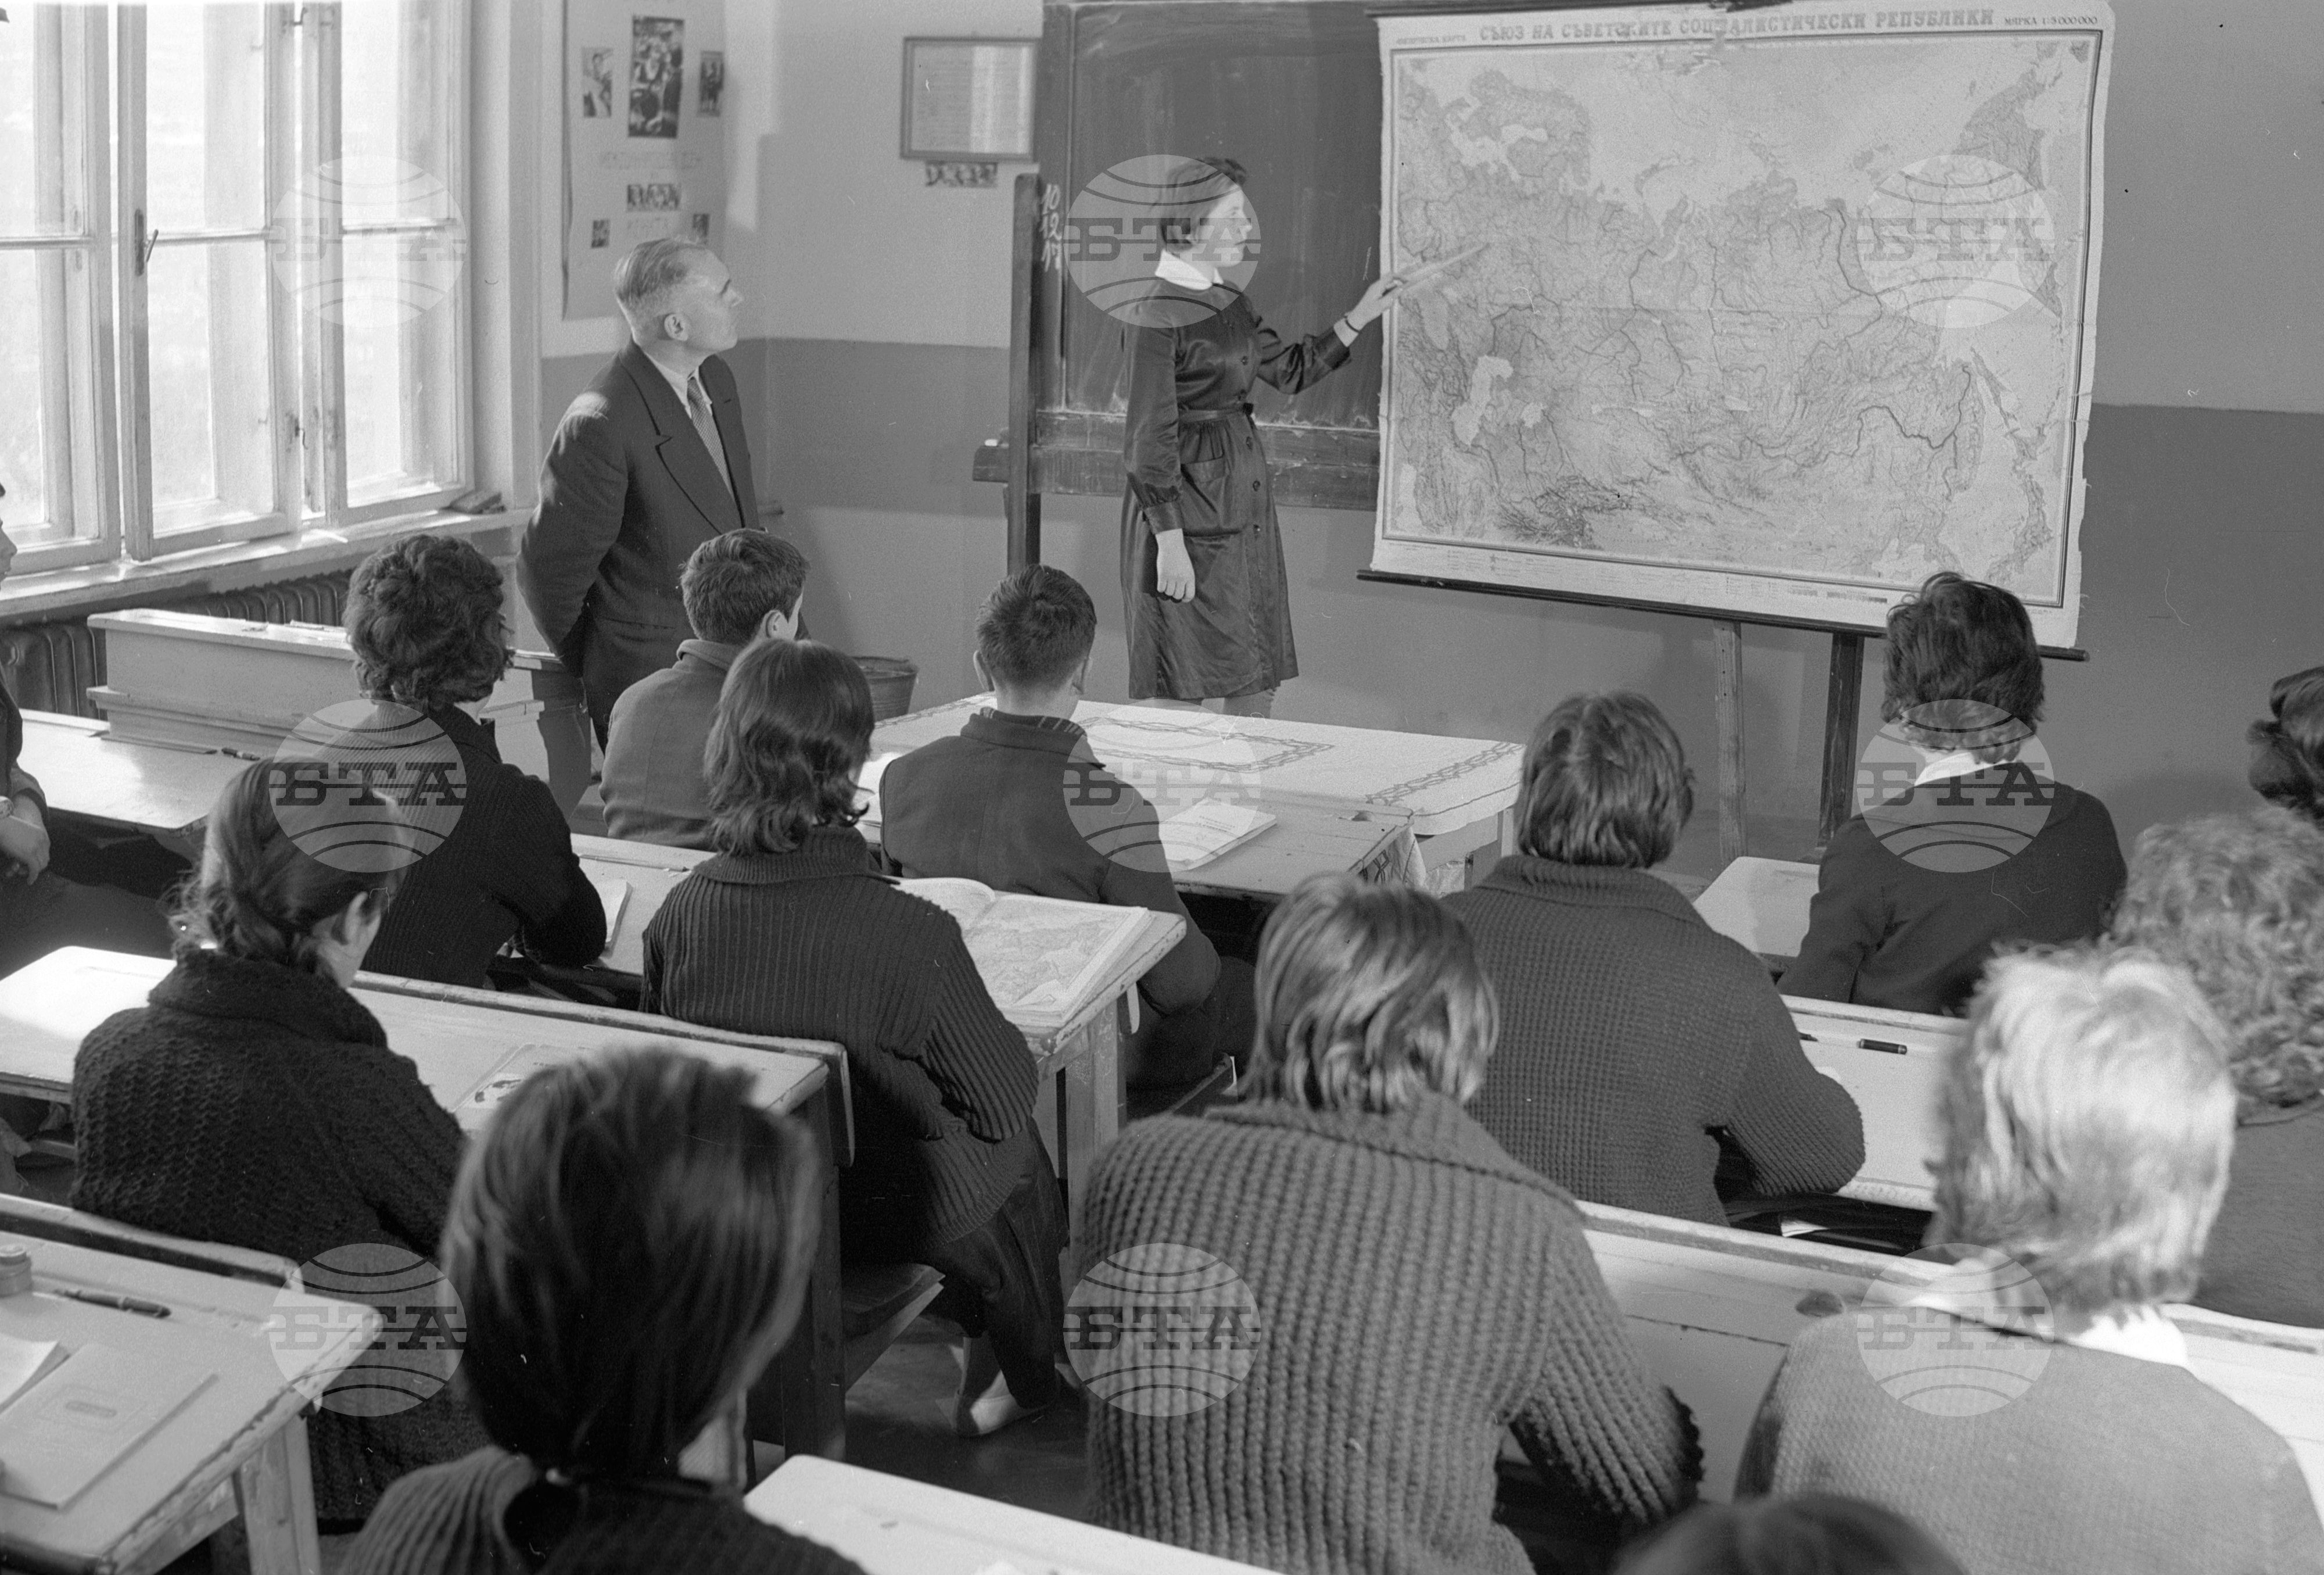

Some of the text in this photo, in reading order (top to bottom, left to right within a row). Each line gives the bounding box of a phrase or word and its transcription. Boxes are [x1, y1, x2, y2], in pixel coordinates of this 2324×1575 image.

[1480, 24, 1524, 41] СЪЮЗ
[1532, 23, 1554, 40] НА
[1875, 8, 1995, 28] РЕПУБЛИКИ
[1041, 184, 1061, 214] 10
[1039, 212, 1063, 241] 12
